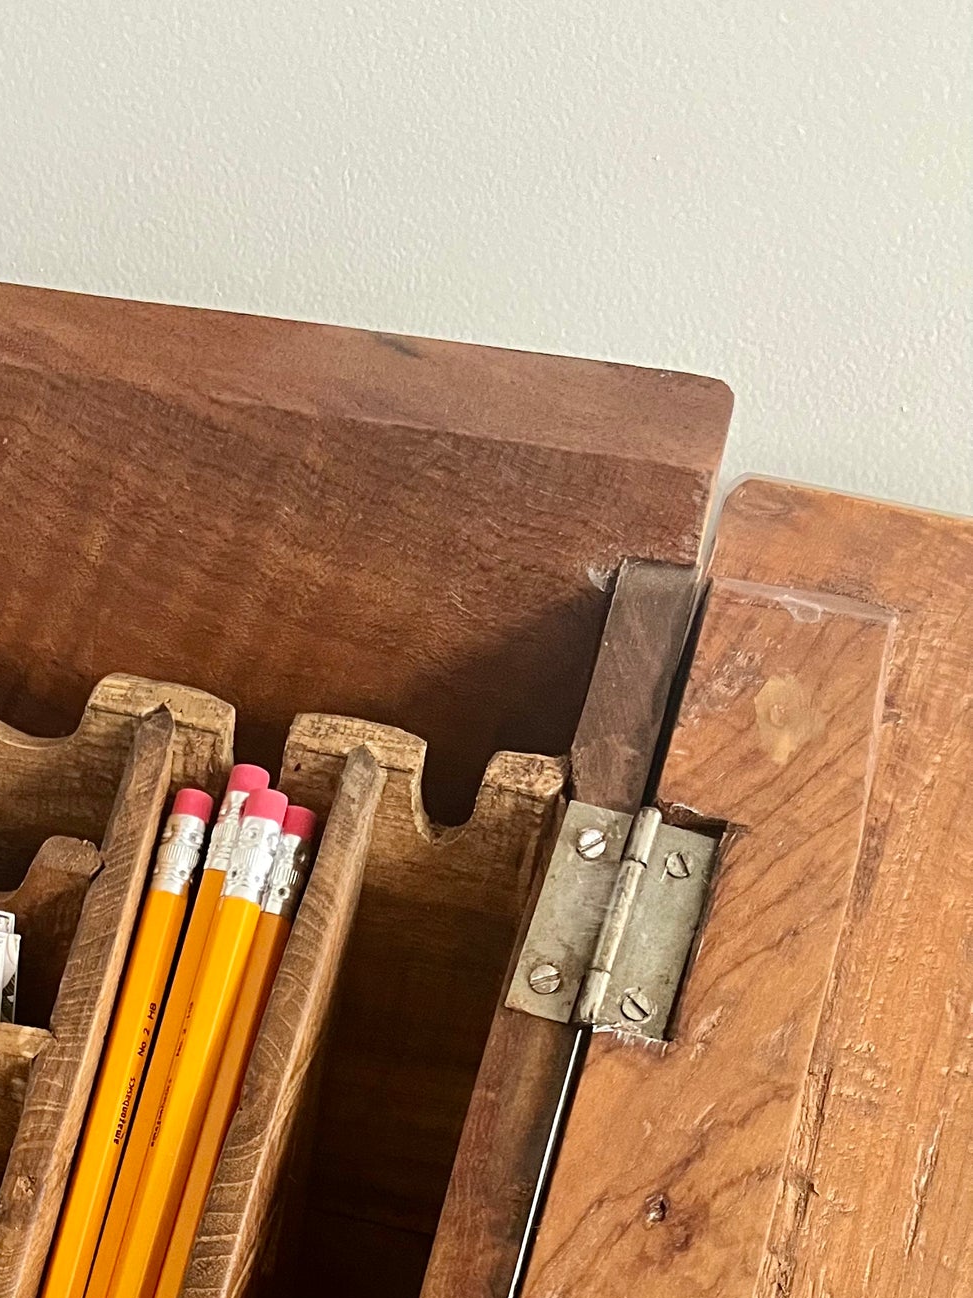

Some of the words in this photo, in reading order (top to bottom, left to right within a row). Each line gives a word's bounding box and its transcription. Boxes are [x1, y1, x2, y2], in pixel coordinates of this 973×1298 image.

[113, 1077, 136, 1145] amazonbasics
[143, 1027, 150, 1036] 2
[147, 1002, 157, 1020] HB
